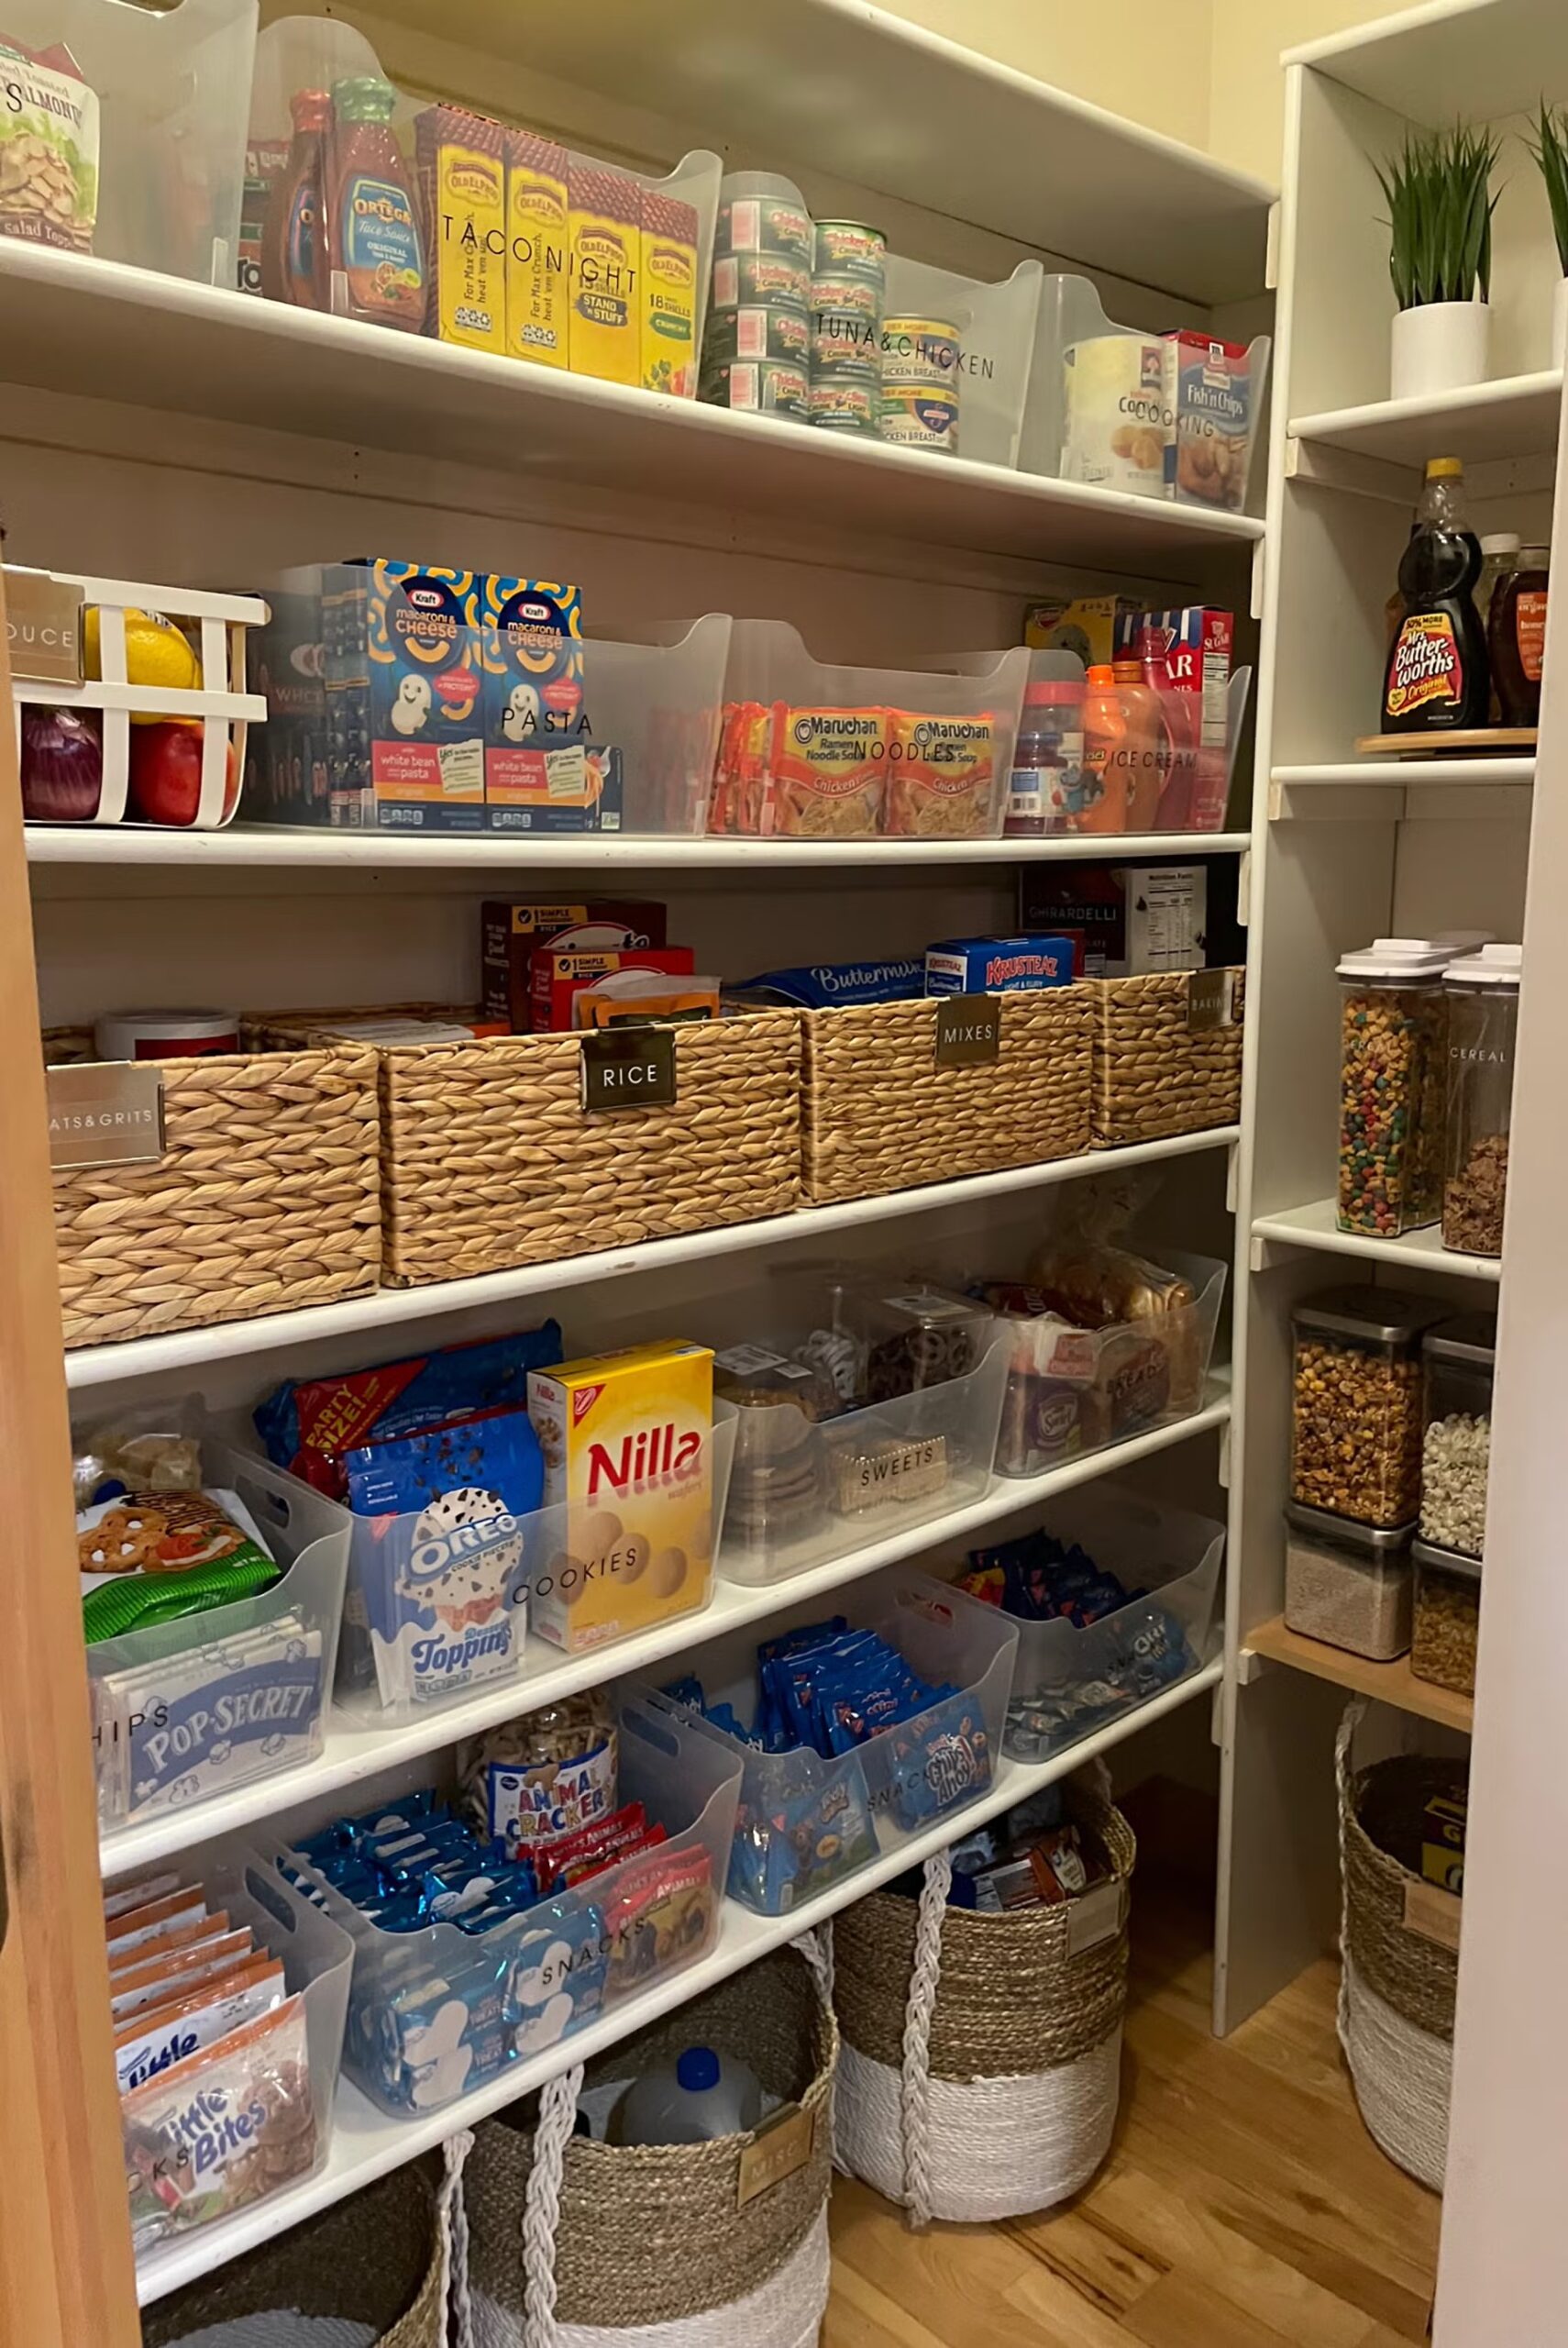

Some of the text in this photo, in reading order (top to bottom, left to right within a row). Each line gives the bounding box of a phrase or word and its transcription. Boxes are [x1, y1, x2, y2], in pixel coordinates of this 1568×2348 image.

[441, 216, 534, 262] TACO
[546, 247, 636, 294] NIGHT
[584, 294, 617, 312] STAND
[650, 294, 664, 309] 18
[593, 309, 624, 325] STUFF
[815, 313, 875, 349] TUNA
[880, 331, 891, 352] &
[898, 335, 995, 380] CHICKEN
[1187, 383, 1206, 404] Fish
[1217, 392, 1243, 418] Chips
[415, 593, 436, 604] Kraft
[396, 608, 447, 623] macaroni
[525, 606, 544, 617] Kraft
[1422, 615, 1443, 624] MORE
[508, 622, 555, 636] macaroni
[1396, 637, 1449, 671] Butter-
[1397, 652, 1454, 687] worth's
[1408, 673, 1447, 700] Original
[501, 707, 592, 736] PASTA
[811, 716, 878, 735] Maruchan
[930, 721, 989, 739] Maruchan
[820, 737, 854, 749] Ramen
[854, 740, 955, 762] NOODLES
[381, 754, 410, 766] white
[411, 755, 436, 767] bean
[806, 749, 841, 761] Noodle
[1110, 750, 1138, 768] ICE
[1143, 750, 1198, 770] CREAM
[401, 768, 429, 780] pasta
[492, 760, 519, 772] white
[511, 773, 537, 785] pasta
[813, 776, 856, 793] Chicken
[1028, 906, 1117, 921] GHIRARDELLI
[811, 960, 925, 992] Buttermilk
[985, 955, 1059, 988] KRUSTEAZ
[944, 1024, 993, 1044] MIXES
[1450, 1047, 1506, 1063] CEREAL
[603, 1065, 657, 1087] RICE
[305, 1382, 353, 1447] PARTY
[587, 1423, 702, 1508] Nilla
[860, 1446, 933, 1487] SWEETS
[411, 1513, 518, 1576] OREO
[513, 1547, 637, 1604] COOKIES
[519, 1767, 601, 1812] ANIMAL
[542, 1916, 646, 1986] SNACKS
[151, 2087, 229, 2144] Little
[194, 2099, 267, 2175] Bites
